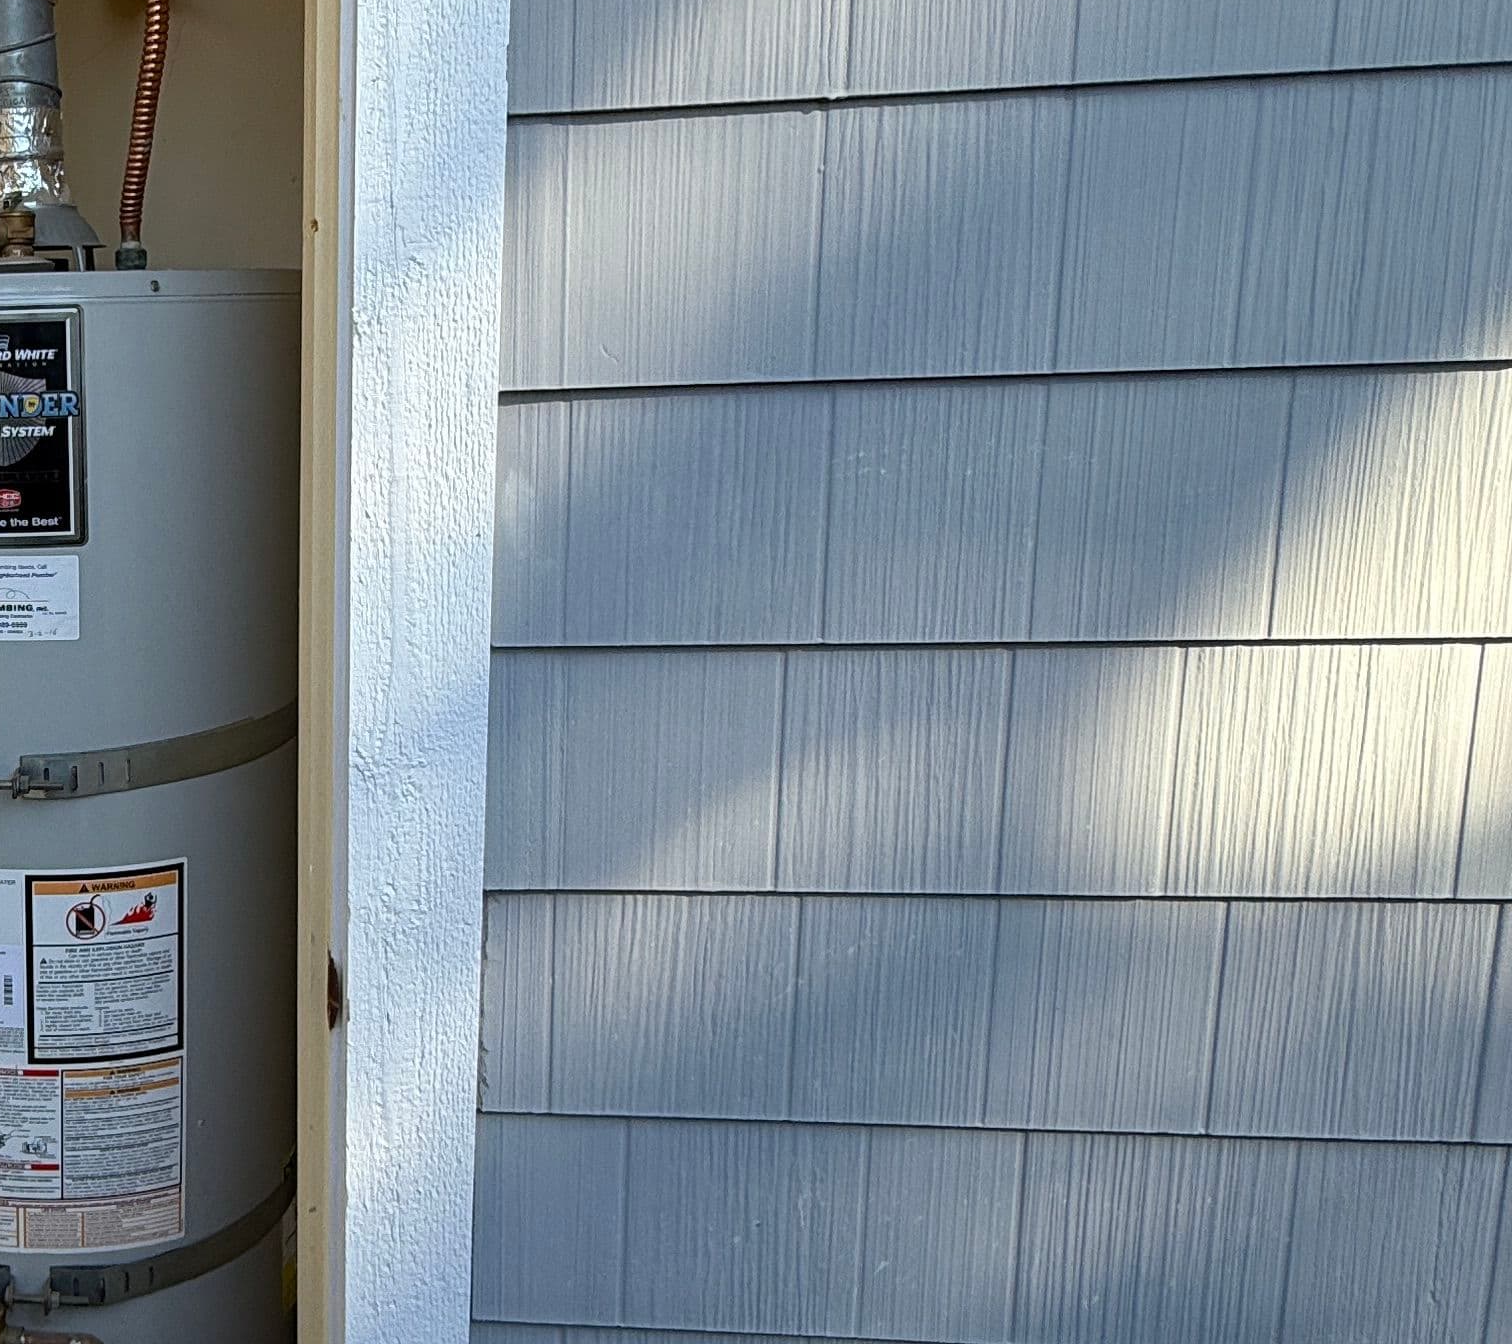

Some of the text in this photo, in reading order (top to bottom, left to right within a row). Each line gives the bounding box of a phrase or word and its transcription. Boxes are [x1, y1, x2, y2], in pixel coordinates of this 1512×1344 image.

[15, 349, 55, 360] WHITE
[1, 426, 55, 437] SYSTEM
[10, 518, 28, 526] the
[32, 517, 58, 526] Best
[91, 880, 136, 892] WARNING
